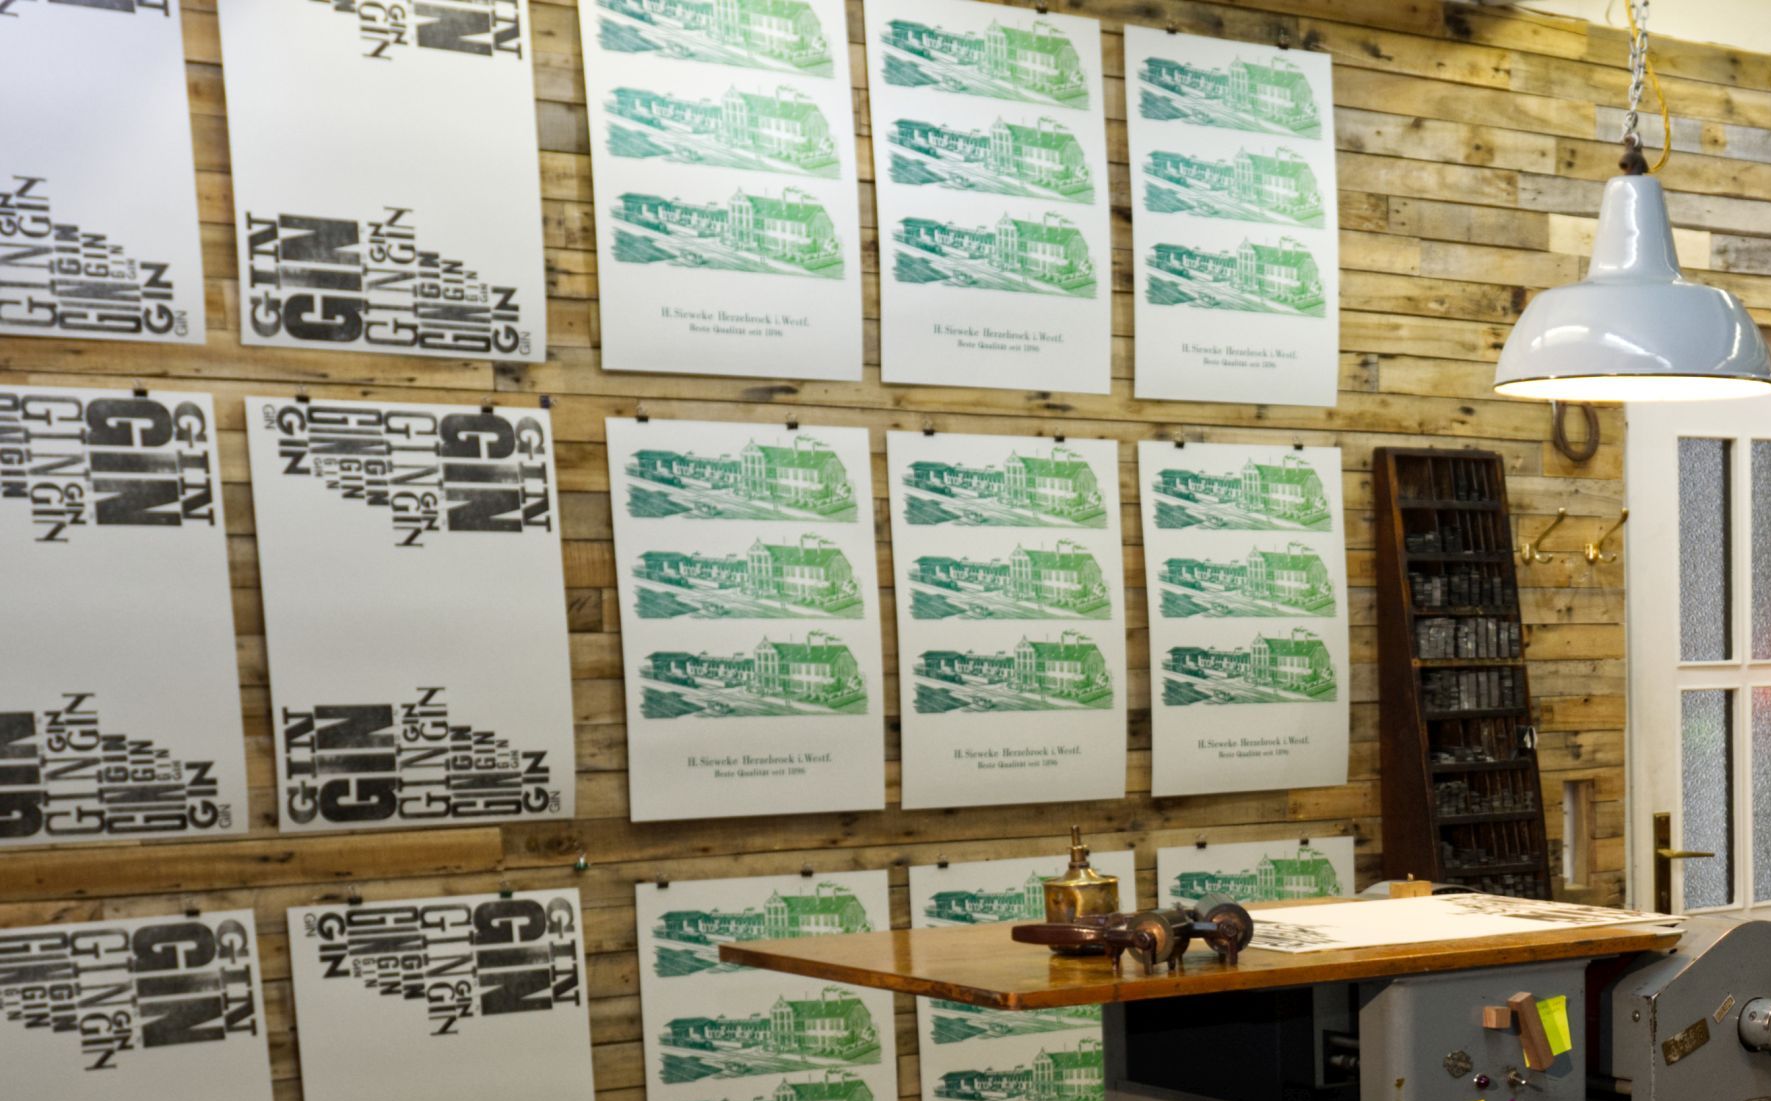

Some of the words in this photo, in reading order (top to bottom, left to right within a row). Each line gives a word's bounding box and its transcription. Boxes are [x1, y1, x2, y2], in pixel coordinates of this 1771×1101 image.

[358, 0, 392, 61] GIN
[388, 4, 408, 46] GIN
[368, 222, 387, 262] GIN
[384, 206, 417, 264] GIN
[246, 211, 282, 338] GIN
[279, 213, 364, 343] GIN
[418, 251, 441, 299] GIN
[442, 260, 465, 301] GIN
[363, 264, 419, 346] GIN
[418, 301, 491, 352] GIN
[492, 286, 520, 353] GIN
[275, 407, 311, 475] GIN
[307, 407, 387, 457] GIN
[383, 411, 443, 490] GIN
[84, 398, 182, 527] GIN
[173, 401, 215, 526] GIN
[338, 458, 365, 499] GIN
[363, 460, 390, 506] GIN
[438, 413, 523, 533] GIN
[516, 416, 552, 532] GIN
[29, 483, 70, 542] GIN
[390, 493, 426, 547] GIN
[420, 493, 440, 531] GIN
[401, 704, 420, 742] GIN
[417, 687, 449, 741] GIN
[282, 706, 319, 825] GIN
[314, 704, 398, 826] GIN
[450, 726, 473, 770] GIN
[474, 731, 496, 770] GIN
[396, 745, 451, 820] GIN
[450, 771, 522, 818] GIN
[522, 751, 549, 814] GIN
[315, 912, 350, 978] GIN
[346, 906, 423, 956] GIN
[419, 903, 477, 980] GIN
[472, 896, 554, 1015] GIN
[546, 897, 582, 1009] GIN
[130, 918, 226, 1048] GIN
[216, 919, 257, 1039] GIN
[376, 955, 402, 996] GIN
[400, 955, 426, 999] GIN
[454, 980, 474, 1016] GIN
[426, 982, 461, 1036] GIN
